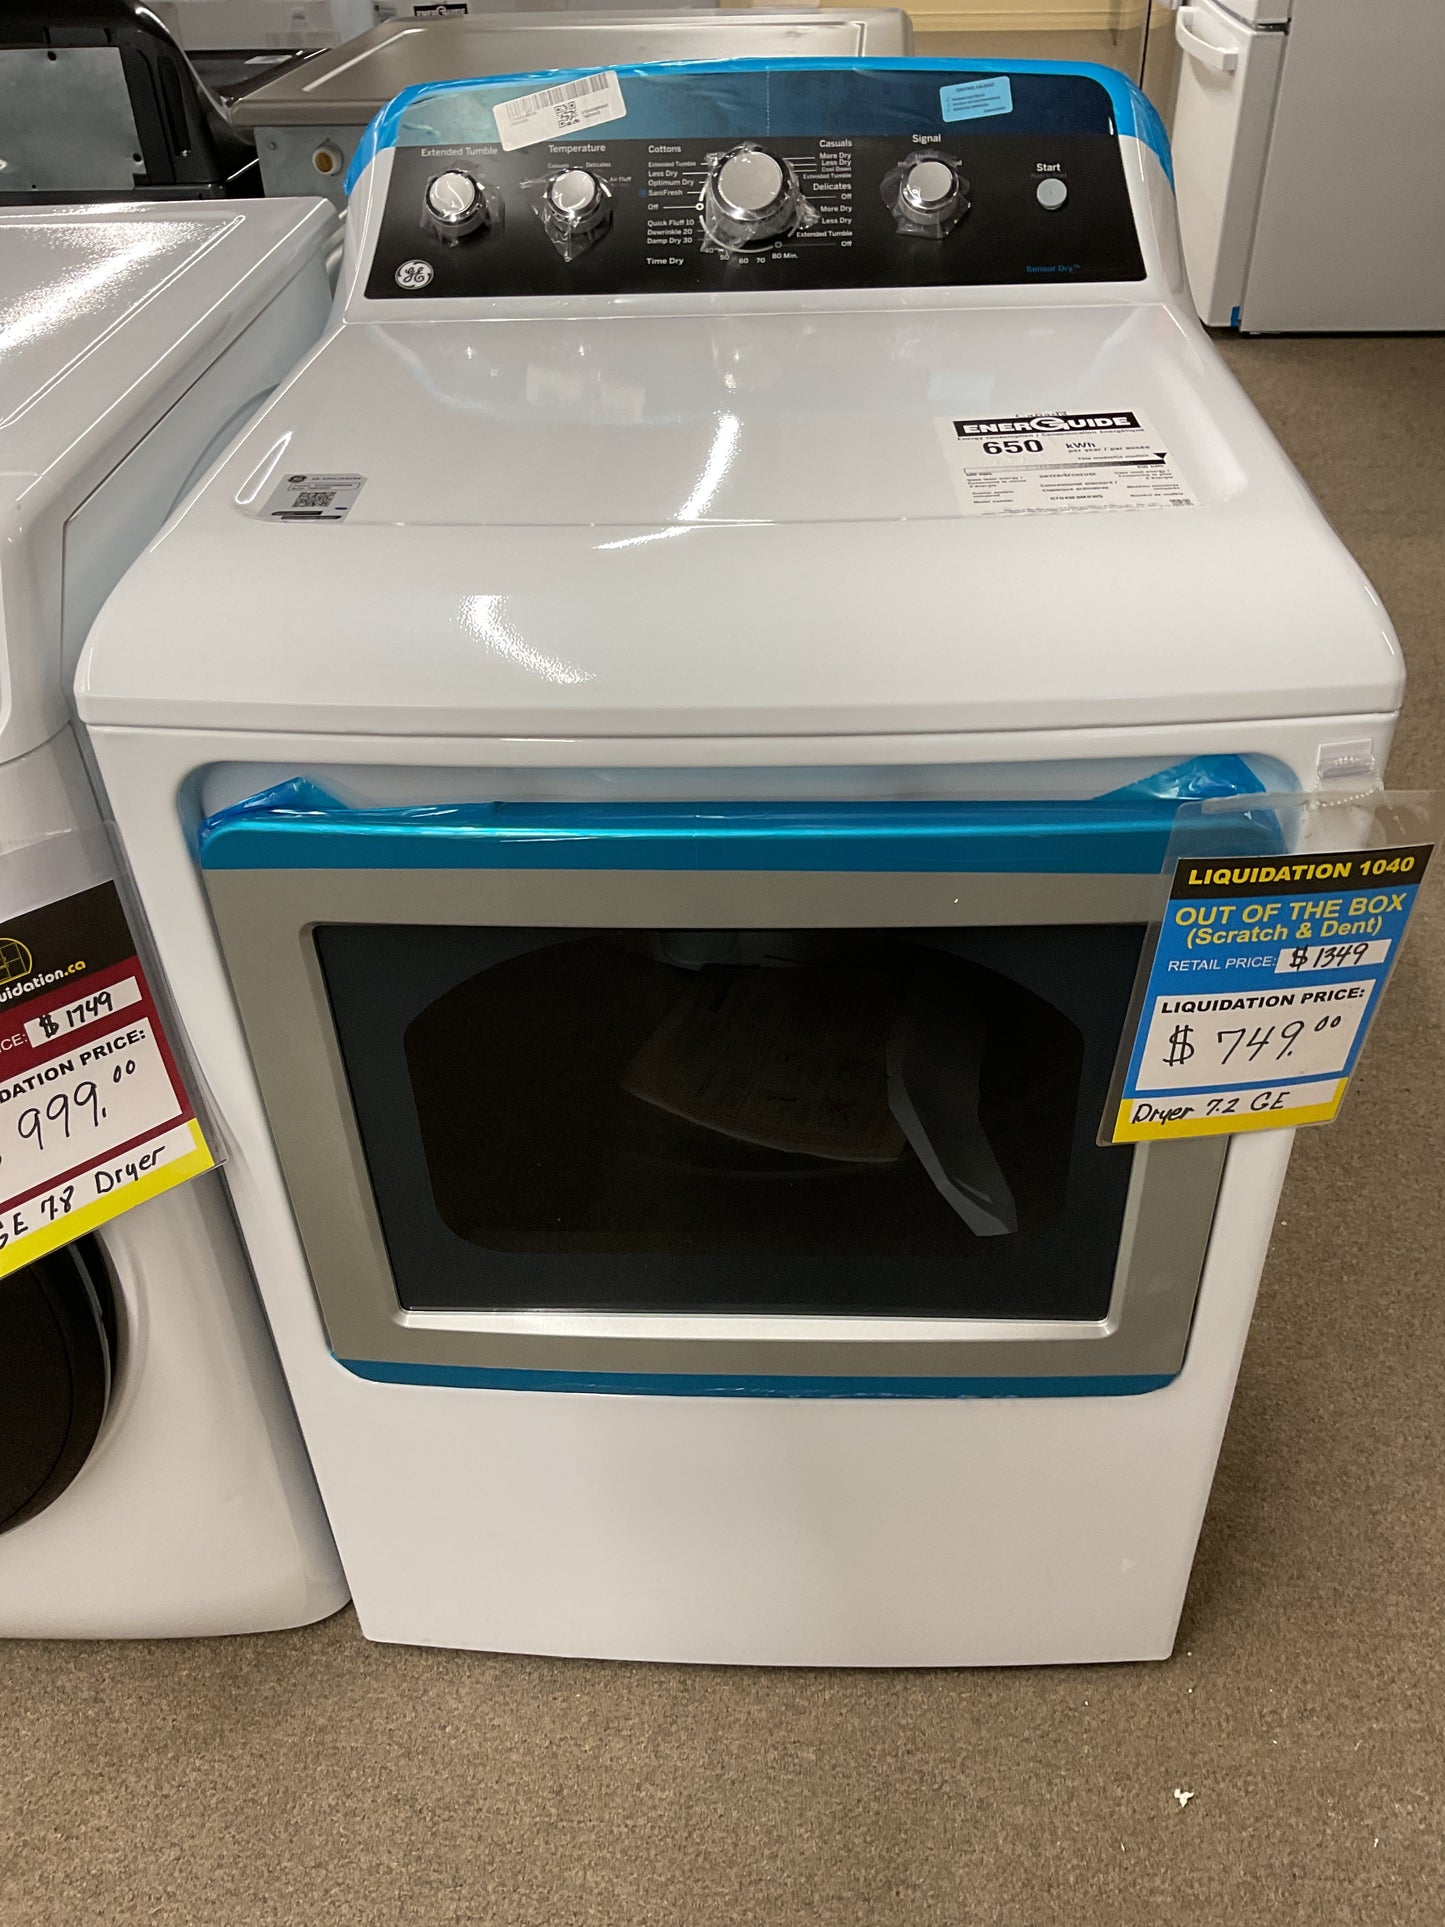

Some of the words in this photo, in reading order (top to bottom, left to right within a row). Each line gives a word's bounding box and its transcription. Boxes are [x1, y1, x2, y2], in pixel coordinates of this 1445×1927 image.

[819, 139, 853, 147] Casuals
[912, 134, 942, 144] Signal
[421, 148, 462, 157] Extended
[465, 147, 498, 156] Tumble
[548, 144, 606, 154] Temperature
[648, 145, 682, 153] Cottons
[839, 152, 852, 160] Dry
[1036, 162, 1061, 173] Start
[665, 170, 678, 178] Dry
[682, 179, 695, 187] Dry
[813, 182, 852, 191] Delicates
[840, 205, 853, 213] Dry
[669, 257, 684, 266] Dry
[1026, 265, 1056, 273] Sensor
[961, 416, 1132, 434] ENERGUIDE
[982, 439, 1044, 456] 650
[1065, 442, 1097, 450] kWh
[1188, 861, 1351, 887] LIQUIDATION
[1358, 856, 1415, 876] 1040
[1175, 905, 1236, 927] OUT
[1242, 903, 1281, 924] OF
[1289, 898, 1343, 920] THE
[1348, 892, 1408, 917] BOX
[1186, 919, 1288, 948] (Scratch
[1295, 922, 1313, 939] &
[1320, 915, 1382, 938] Dent)
[1167, 958, 1221, 972] RETAIL
[1225, 955, 1277, 970] PRICE:
[1161, 994, 1295, 1014] LIQUIDATION
[1300, 987, 1364, 1004] PRICE:
[0, 1033, 28, 1052] CE:
[79, 1029, 147, 1067] PRICE:
[1131, 1103, 1195, 1125] Dryer
[1206, 1097, 1236, 1116] 7.2
[1250, 1091, 1290, 1110] GE
[94, 1145, 166, 1194] Dryer
